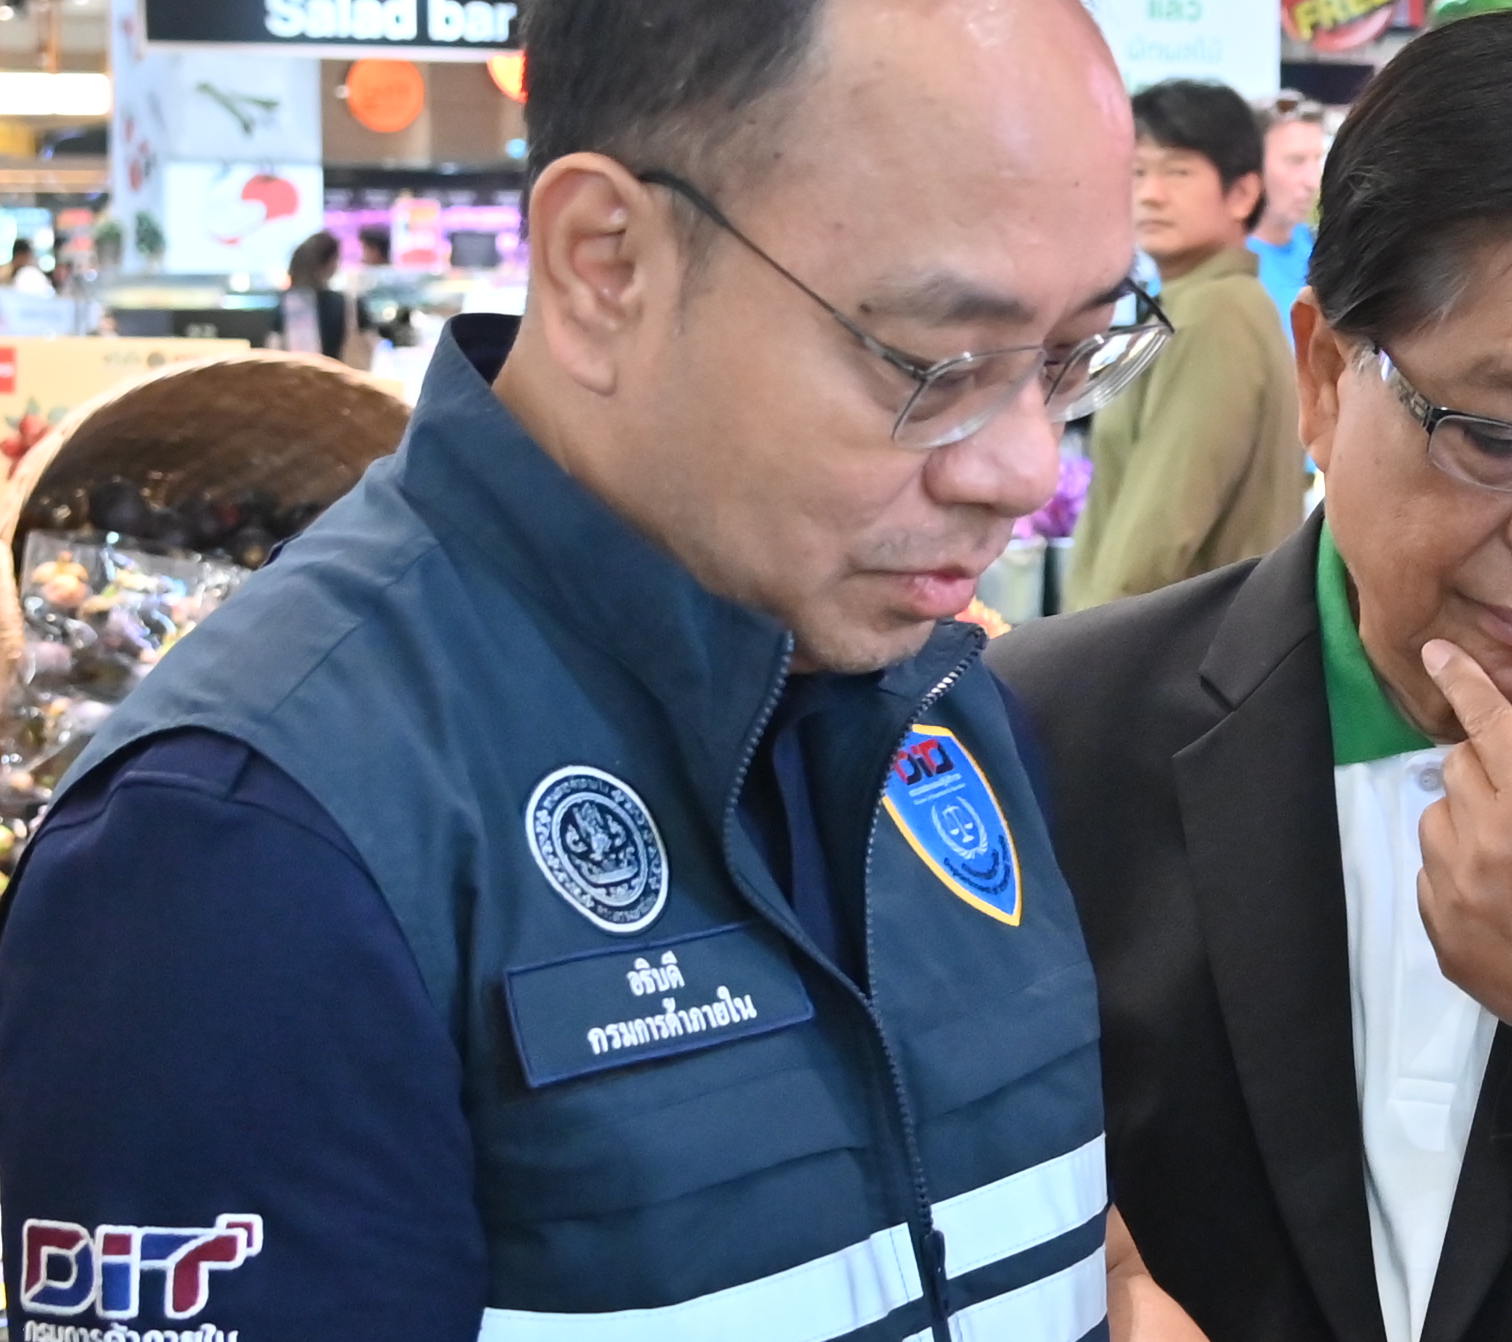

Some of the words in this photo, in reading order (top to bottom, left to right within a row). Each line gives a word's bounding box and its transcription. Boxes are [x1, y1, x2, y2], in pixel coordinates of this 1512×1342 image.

[626, 949, 685, 997] อธิบดี
[587, 985, 758, 1056] กรมการค้าภายใน
